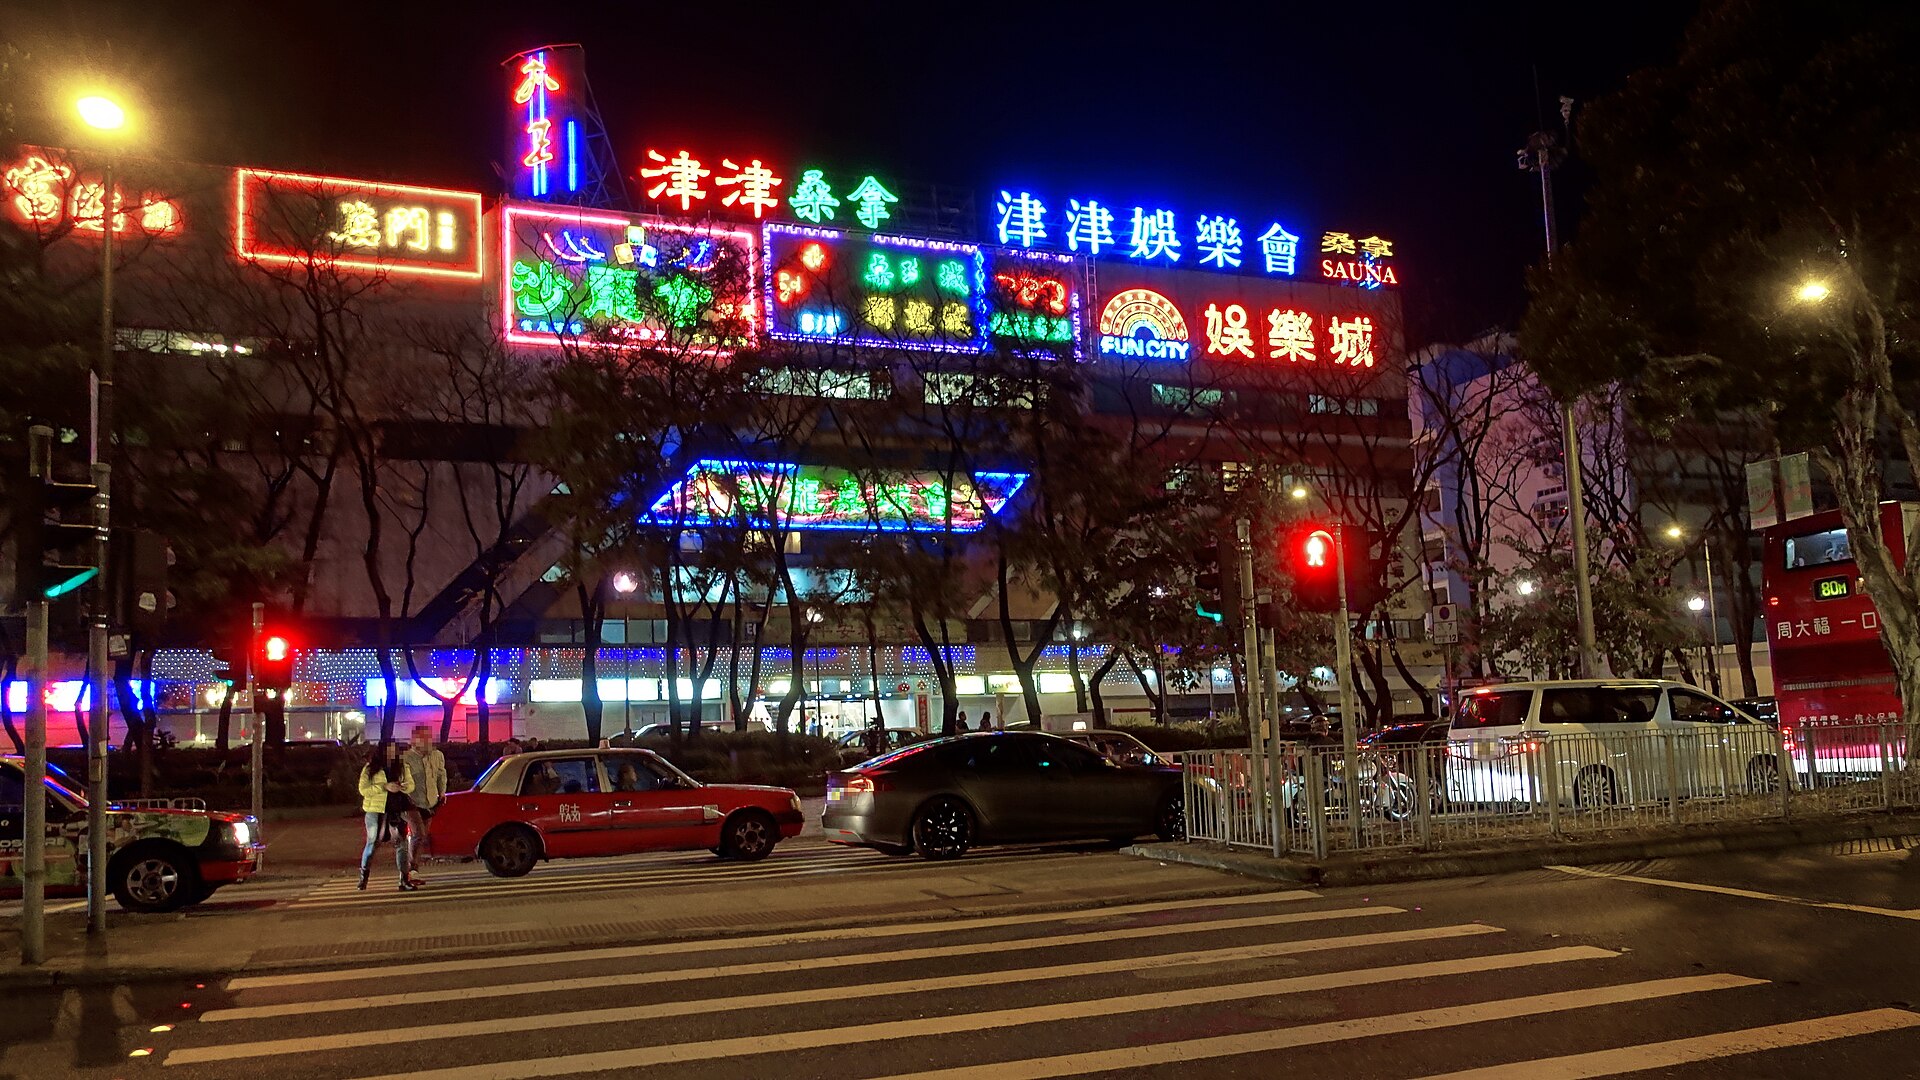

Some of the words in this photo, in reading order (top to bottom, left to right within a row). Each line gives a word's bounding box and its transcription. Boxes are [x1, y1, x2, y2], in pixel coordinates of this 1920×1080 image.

[641, 150, 899, 229] 津津桑拿
[996, 190, 1299, 276] 津津娛樂會
[1321, 231, 1393, 257] 桑拿
[1322, 259, 1398, 284] SAUNA
[1100, 336, 1145, 357] FUN
[1204, 303, 1374, 368] 娛樂城
[1821, 581, 1847, 597] 80M
[1777, 616, 1831, 640] 周大福
[559, 812, 580, 823] TAXI
[560, 803, 580, 813] 的士
